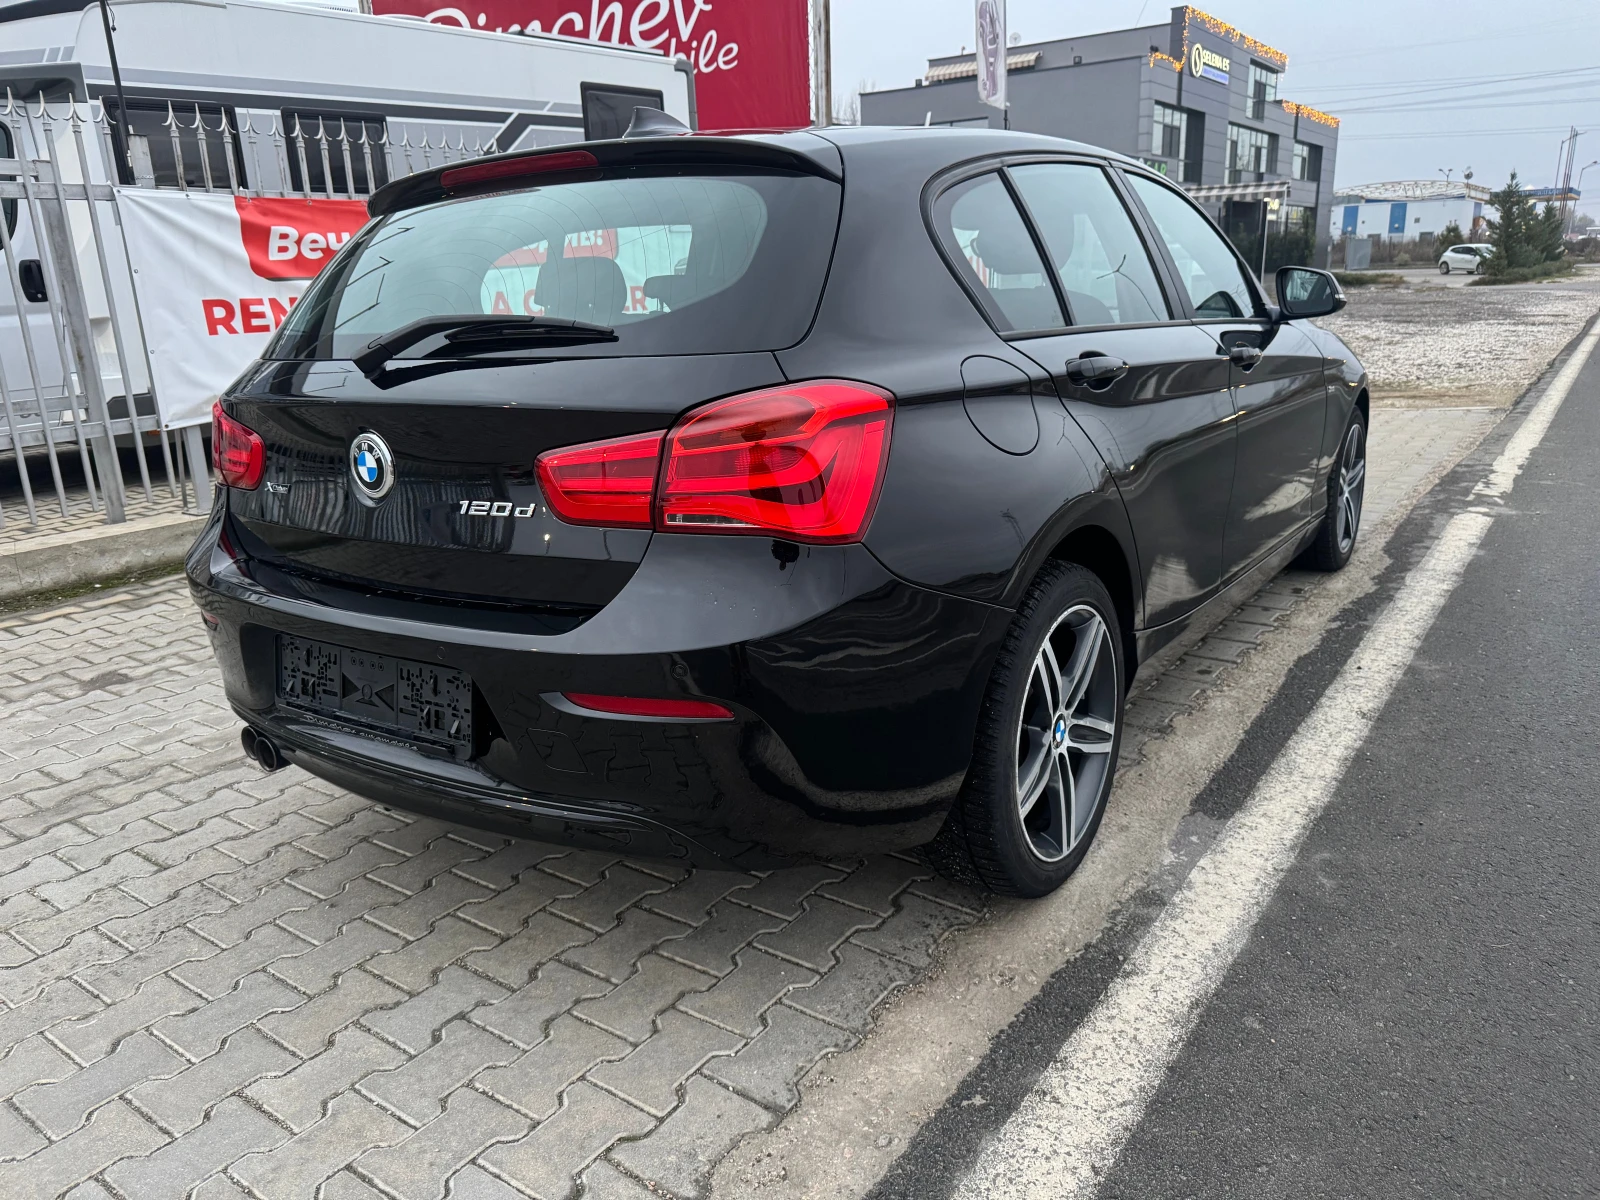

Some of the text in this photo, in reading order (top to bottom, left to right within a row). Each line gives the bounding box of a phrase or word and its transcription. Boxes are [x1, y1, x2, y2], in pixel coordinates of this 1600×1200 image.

[426, 0, 712, 48] chev
[202, 297, 298, 336] REN
[459, 500, 536, 518] 120d
